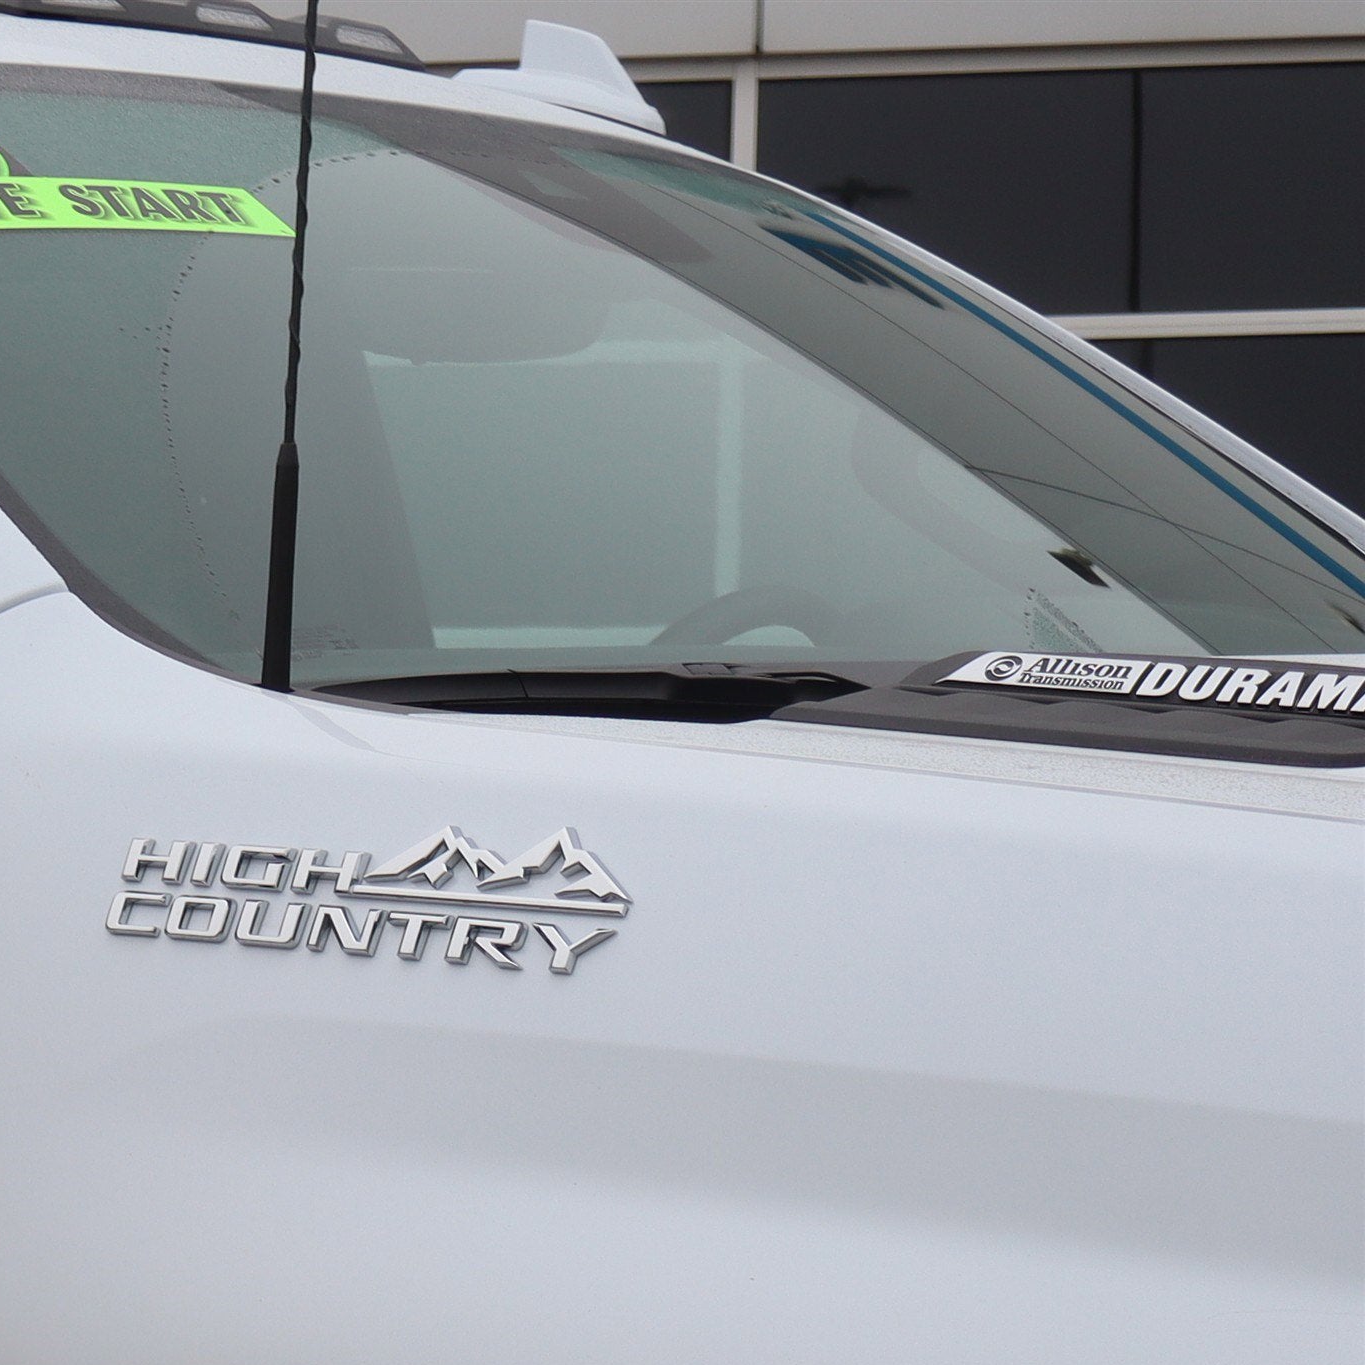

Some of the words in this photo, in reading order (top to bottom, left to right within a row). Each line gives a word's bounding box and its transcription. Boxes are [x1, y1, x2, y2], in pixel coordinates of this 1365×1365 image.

[57, 184, 247, 226] START
[1017, 672, 1126, 692] Transmission
[1021, 656, 1134, 680] Allison
[120, 837, 372, 896] HIGH
[104, 890, 619, 976] COUNTRY
